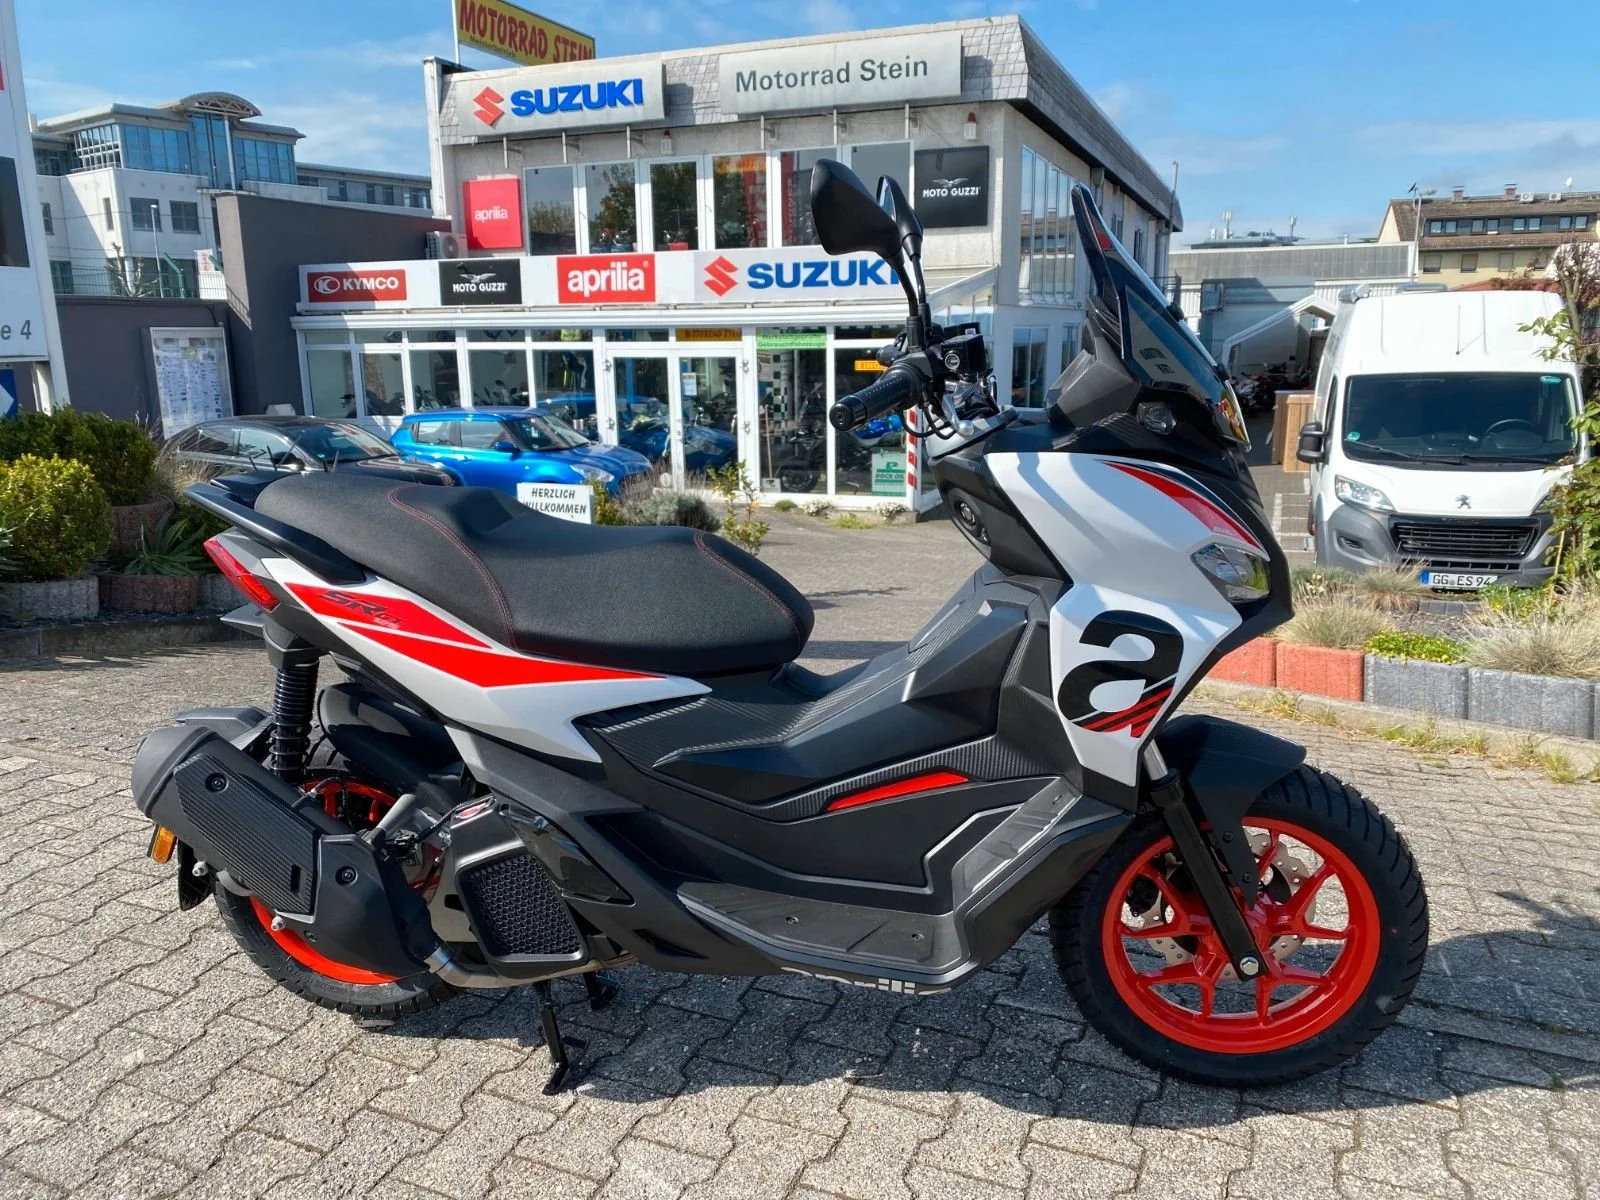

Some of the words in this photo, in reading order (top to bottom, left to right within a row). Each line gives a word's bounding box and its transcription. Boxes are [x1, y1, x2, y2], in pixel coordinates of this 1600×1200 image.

[460, 0, 548, 59] MOTORRAD
[735, 62, 850, 92] Motorrad
[860, 55, 928, 82] Stein
[510, 78, 643, 116] SUZUKI
[922, 189, 948, 197] MOTO
[950, 186, 980, 196] GUZZI
[474, 205, 509, 223] aprilia
[343, 276, 400, 290] KYMCO
[452, 283, 477, 292] MOTO
[478, 281, 506, 291] GUZZI
[567, 260, 645, 297] aprilia
[20, 319, 32, 340] 4
[531, 487, 576, 500] HERZLICH
[1432, 574, 1449, 585] GG
[1456, 575, 1474, 587] ES
